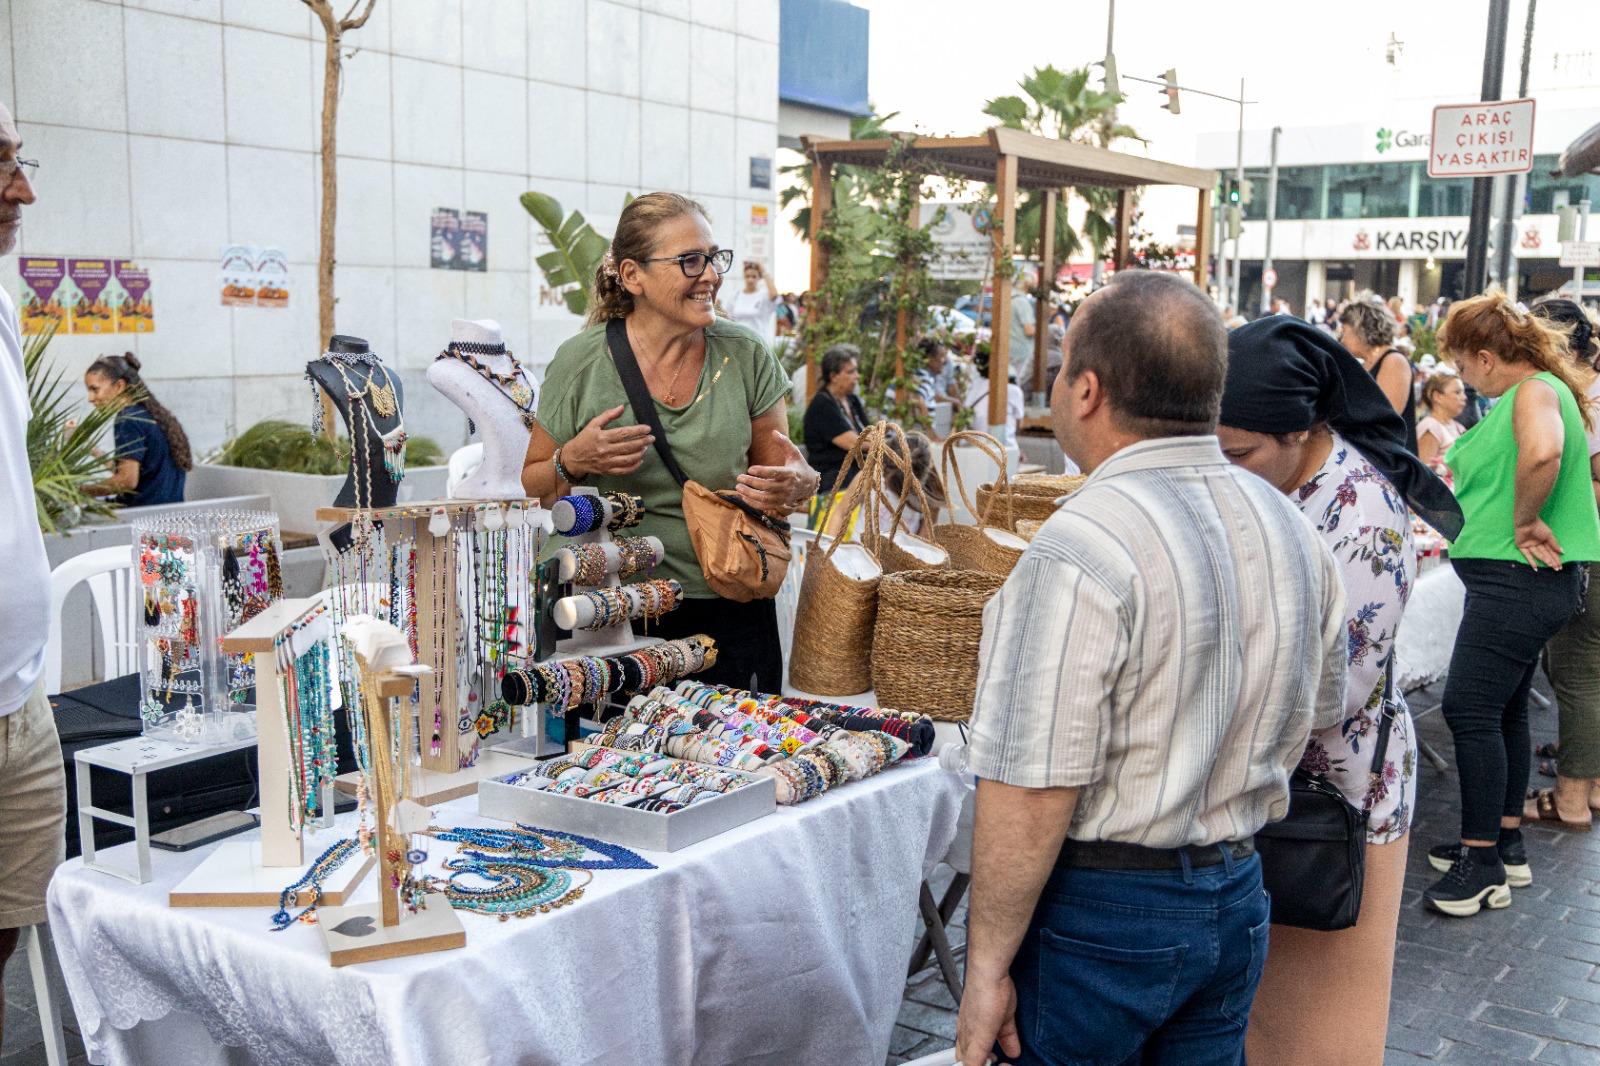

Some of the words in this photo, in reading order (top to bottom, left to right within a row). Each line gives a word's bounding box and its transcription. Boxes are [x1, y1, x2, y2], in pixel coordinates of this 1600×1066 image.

[1460, 110, 1512, 126] ARAÇ
[1456, 130, 1514, 148] ÇIKIŞI
[1436, 148, 1528, 166] YASAKTIR
[1376, 230, 1493, 252] KARŞIY
